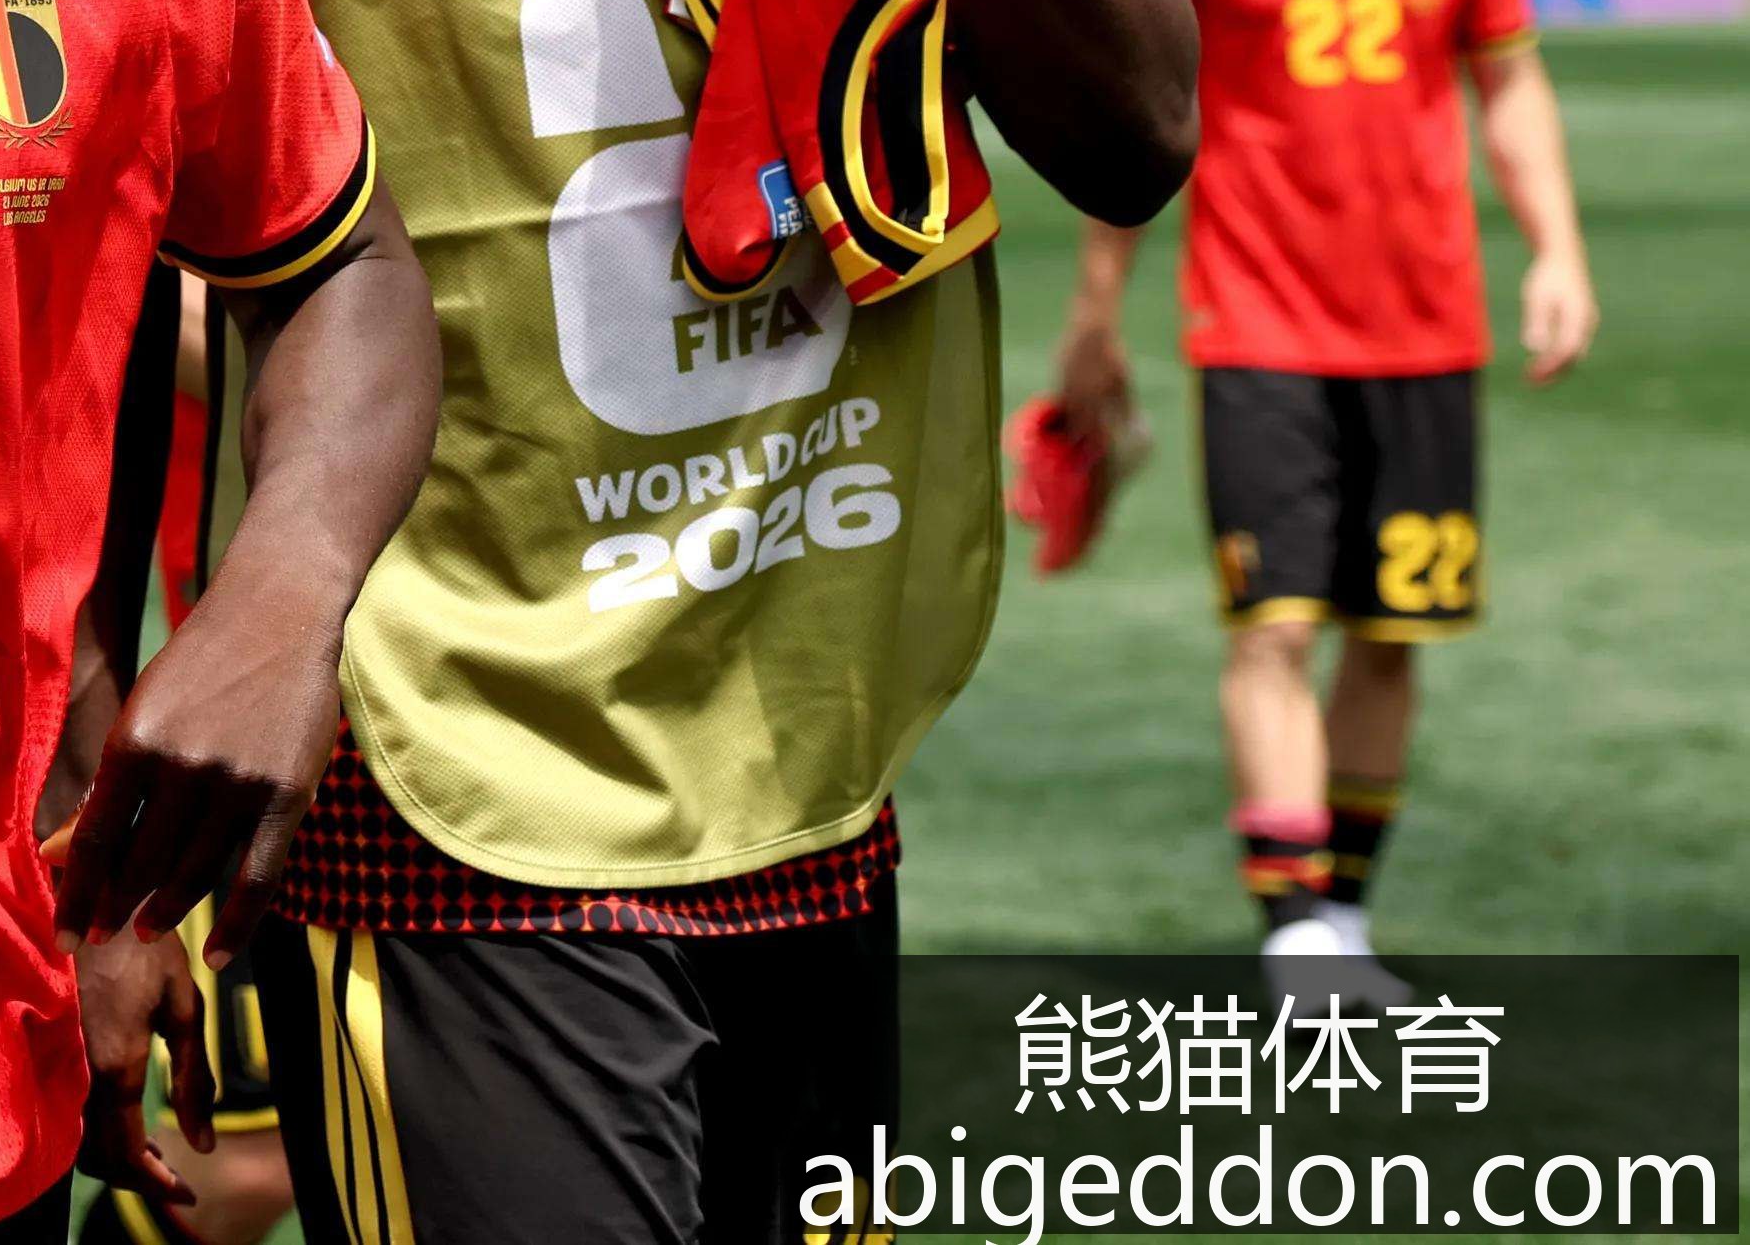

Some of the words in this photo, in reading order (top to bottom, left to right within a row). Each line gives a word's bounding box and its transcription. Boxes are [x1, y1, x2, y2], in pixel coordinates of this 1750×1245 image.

[3, 211, 14, 226] LOS
[14, 210, 46, 224] ANGELES
[10, 195, 30, 208] JUNE
[672, 285, 824, 374] FIFA
[575, 431, 798, 523] WORLD
[801, 396, 881, 467] CUP
[581, 463, 902, 614] 2026
[1377, 510, 1478, 612] 22
